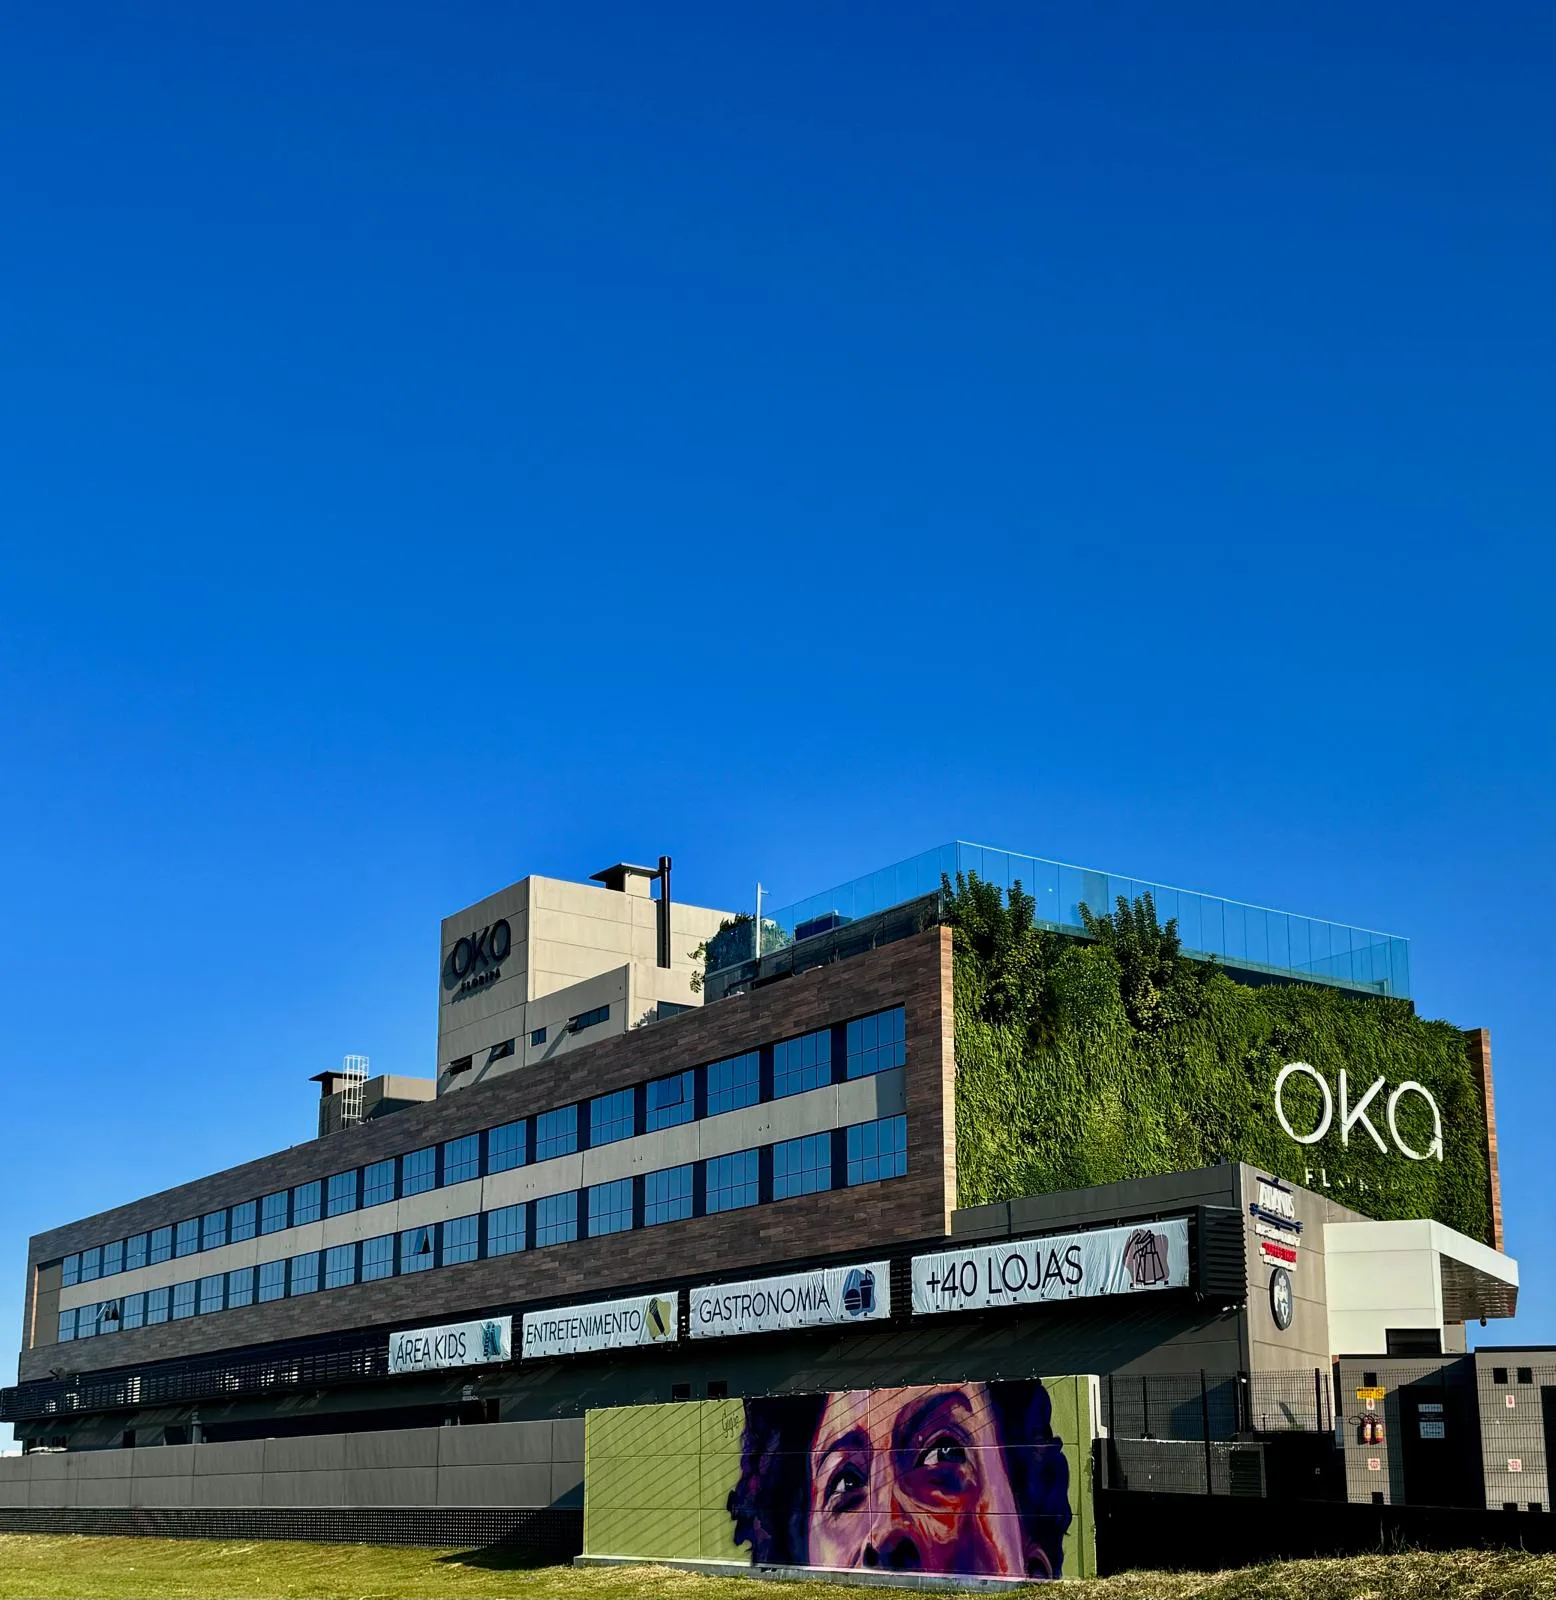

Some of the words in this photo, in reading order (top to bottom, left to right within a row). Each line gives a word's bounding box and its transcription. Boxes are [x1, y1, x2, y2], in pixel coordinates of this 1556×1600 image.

[926, 1260, 978, 1298] +40
[988, 1245, 1083, 1295] LOJAS
[700, 1284, 831, 1323] GASTRONOMIA
[526, 1309, 641, 1344] ENTRETENIMENTO
[395, 1334, 431, 1367] ÁREA
[434, 1331, 467, 1361] KIDS
